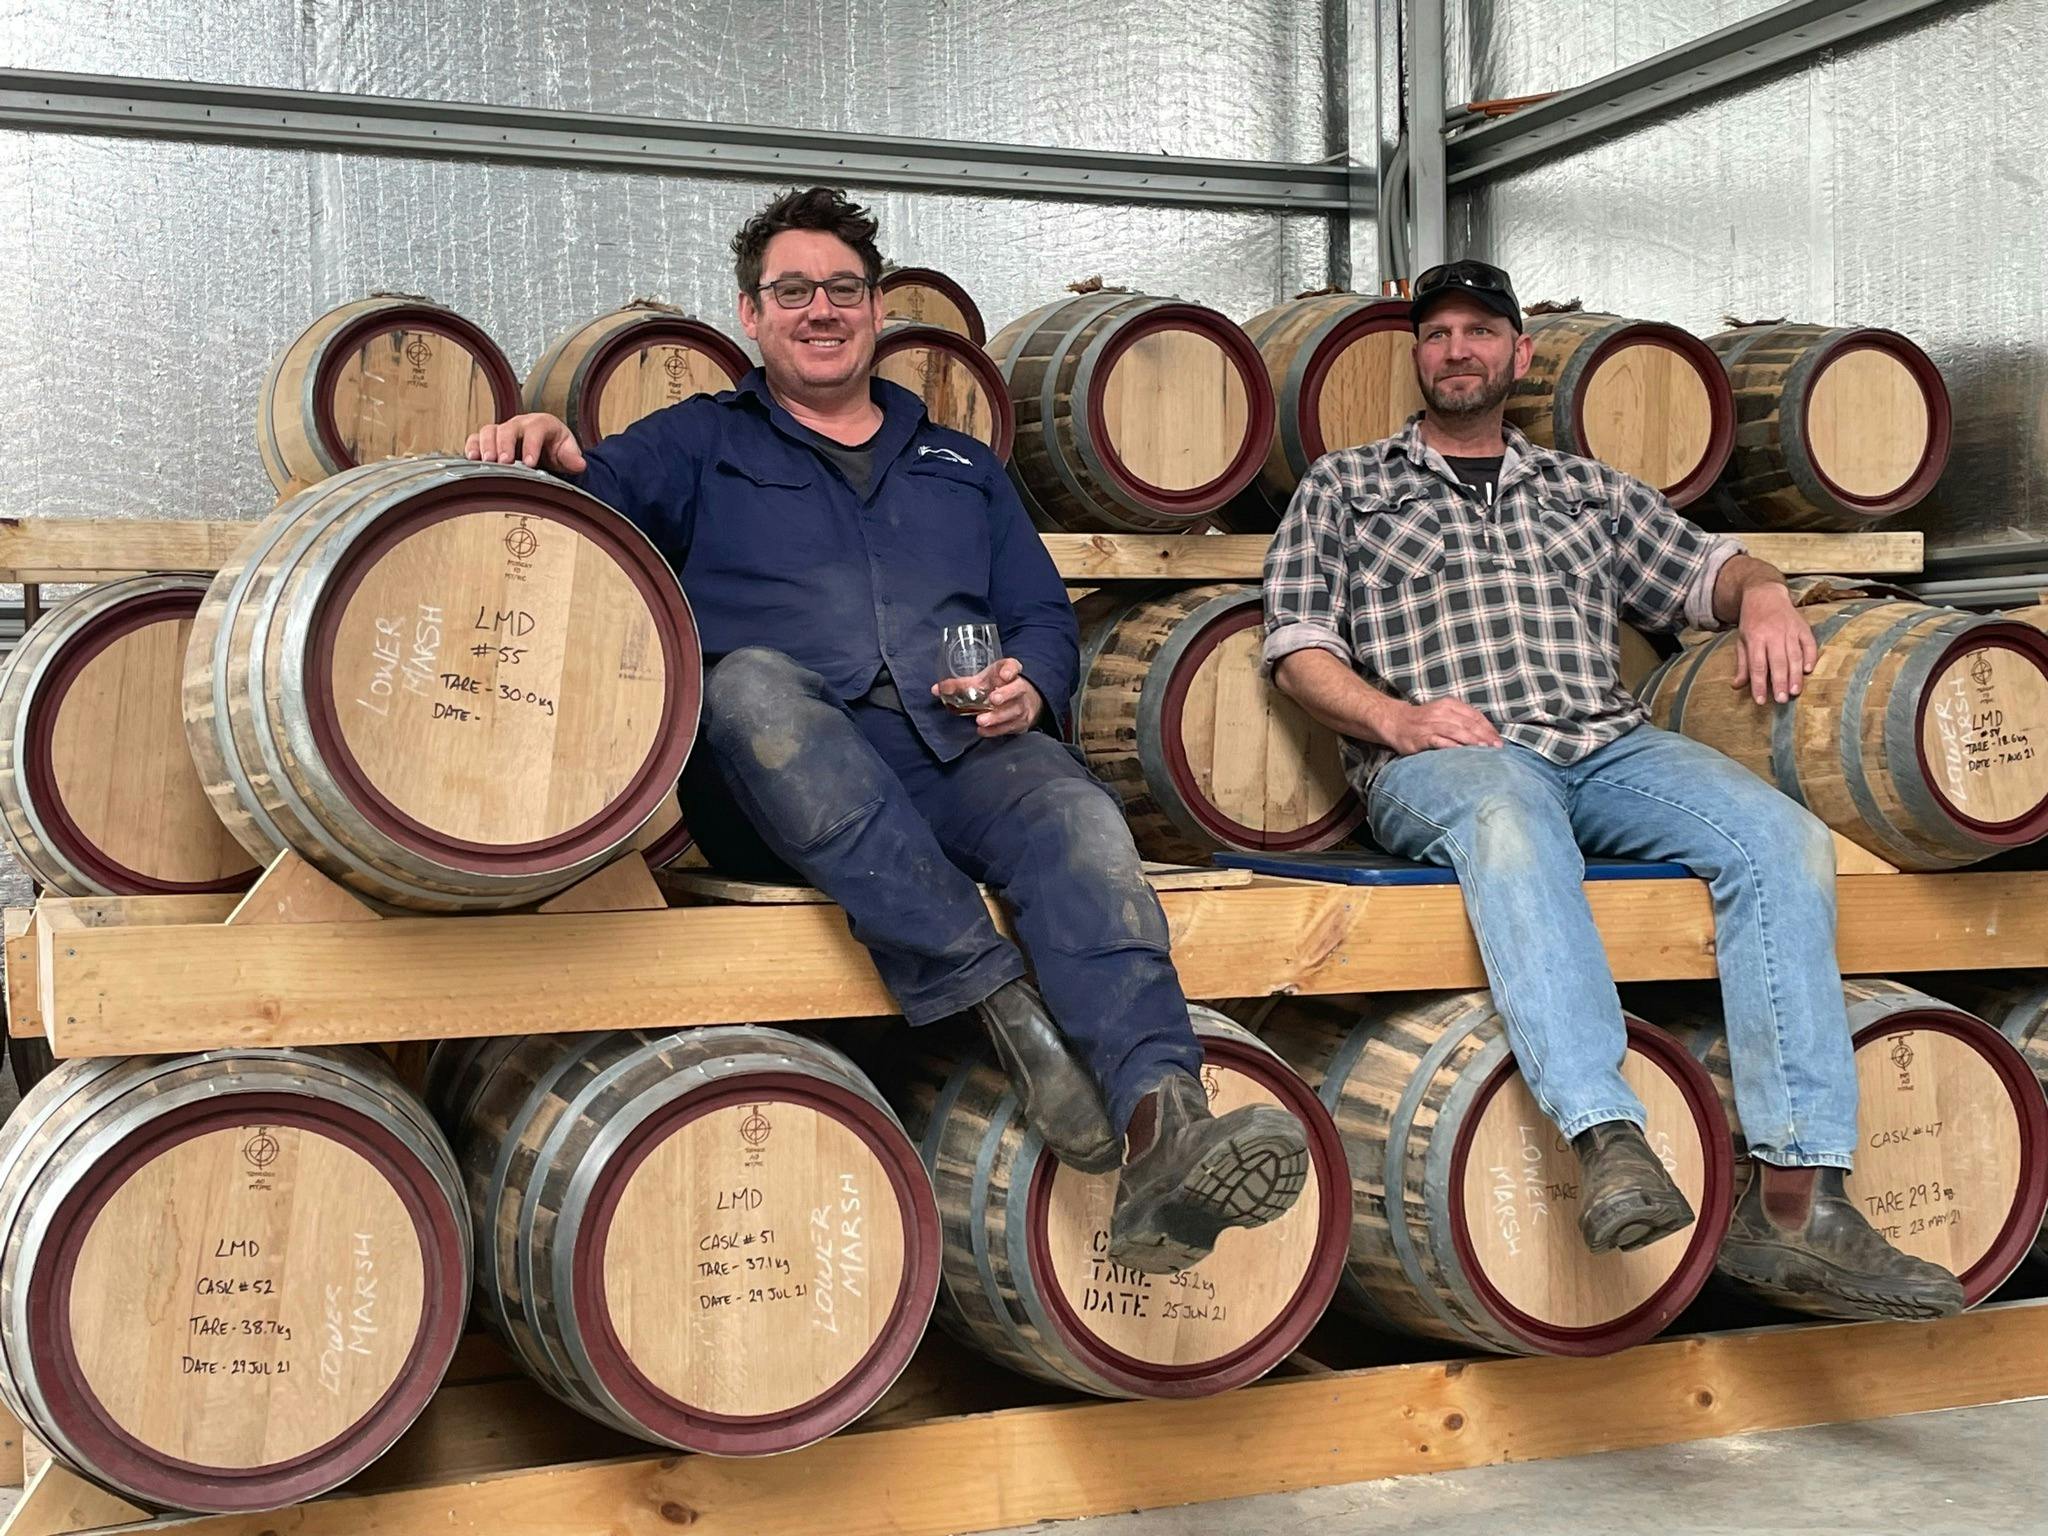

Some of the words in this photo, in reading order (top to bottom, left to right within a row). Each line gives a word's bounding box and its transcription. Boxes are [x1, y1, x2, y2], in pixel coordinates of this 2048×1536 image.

[474, 605, 535, 636] LMD
[1972, 709, 2003, 731] LMD
[1870, 1126, 1911, 1149] CASK
[717, 1187, 763, 1211] LMD
[1865, 1190, 1905, 1217] TARE
[215, 1238, 260, 1258] LMD
[700, 1232, 740, 1251] CASK
[197, 1277, 235, 1295] CASK
[1083, 1287, 1150, 1318] DATE
